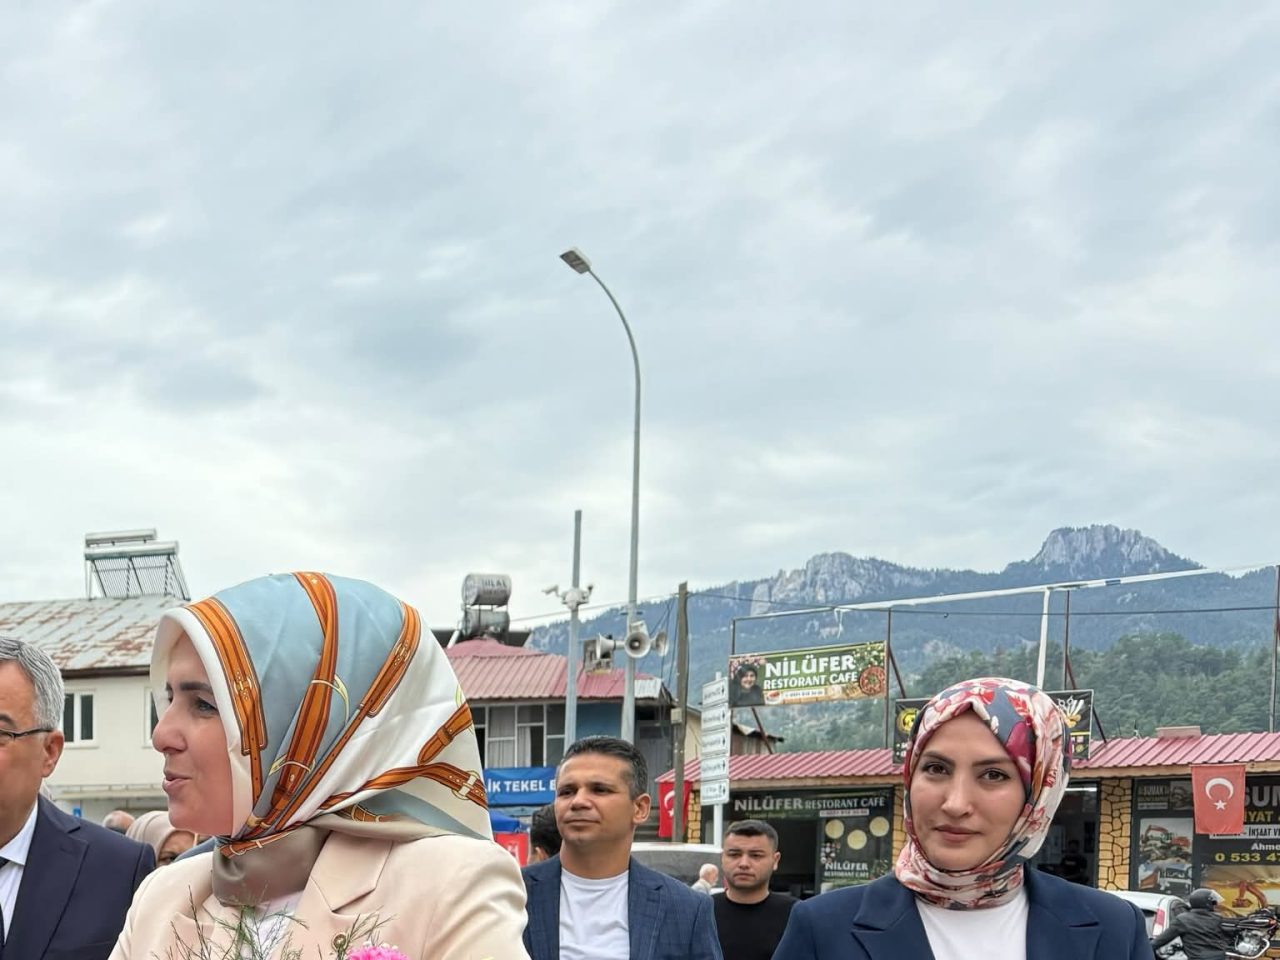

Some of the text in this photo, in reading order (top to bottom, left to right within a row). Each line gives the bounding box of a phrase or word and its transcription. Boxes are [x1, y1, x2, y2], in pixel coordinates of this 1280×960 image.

[765, 654, 856, 677] NİLÜFER
[764, 671, 858, 690] RESTORANT CAFE
[504, 779, 546, 793] TEKEL
[734, 796, 885, 811] NİLÜFER RESTORANT CAFE
[1215, 852, 1225, 862] 0
[1231, 852, 1260, 862] 533
[825, 860, 869, 871] NİLÜFER
